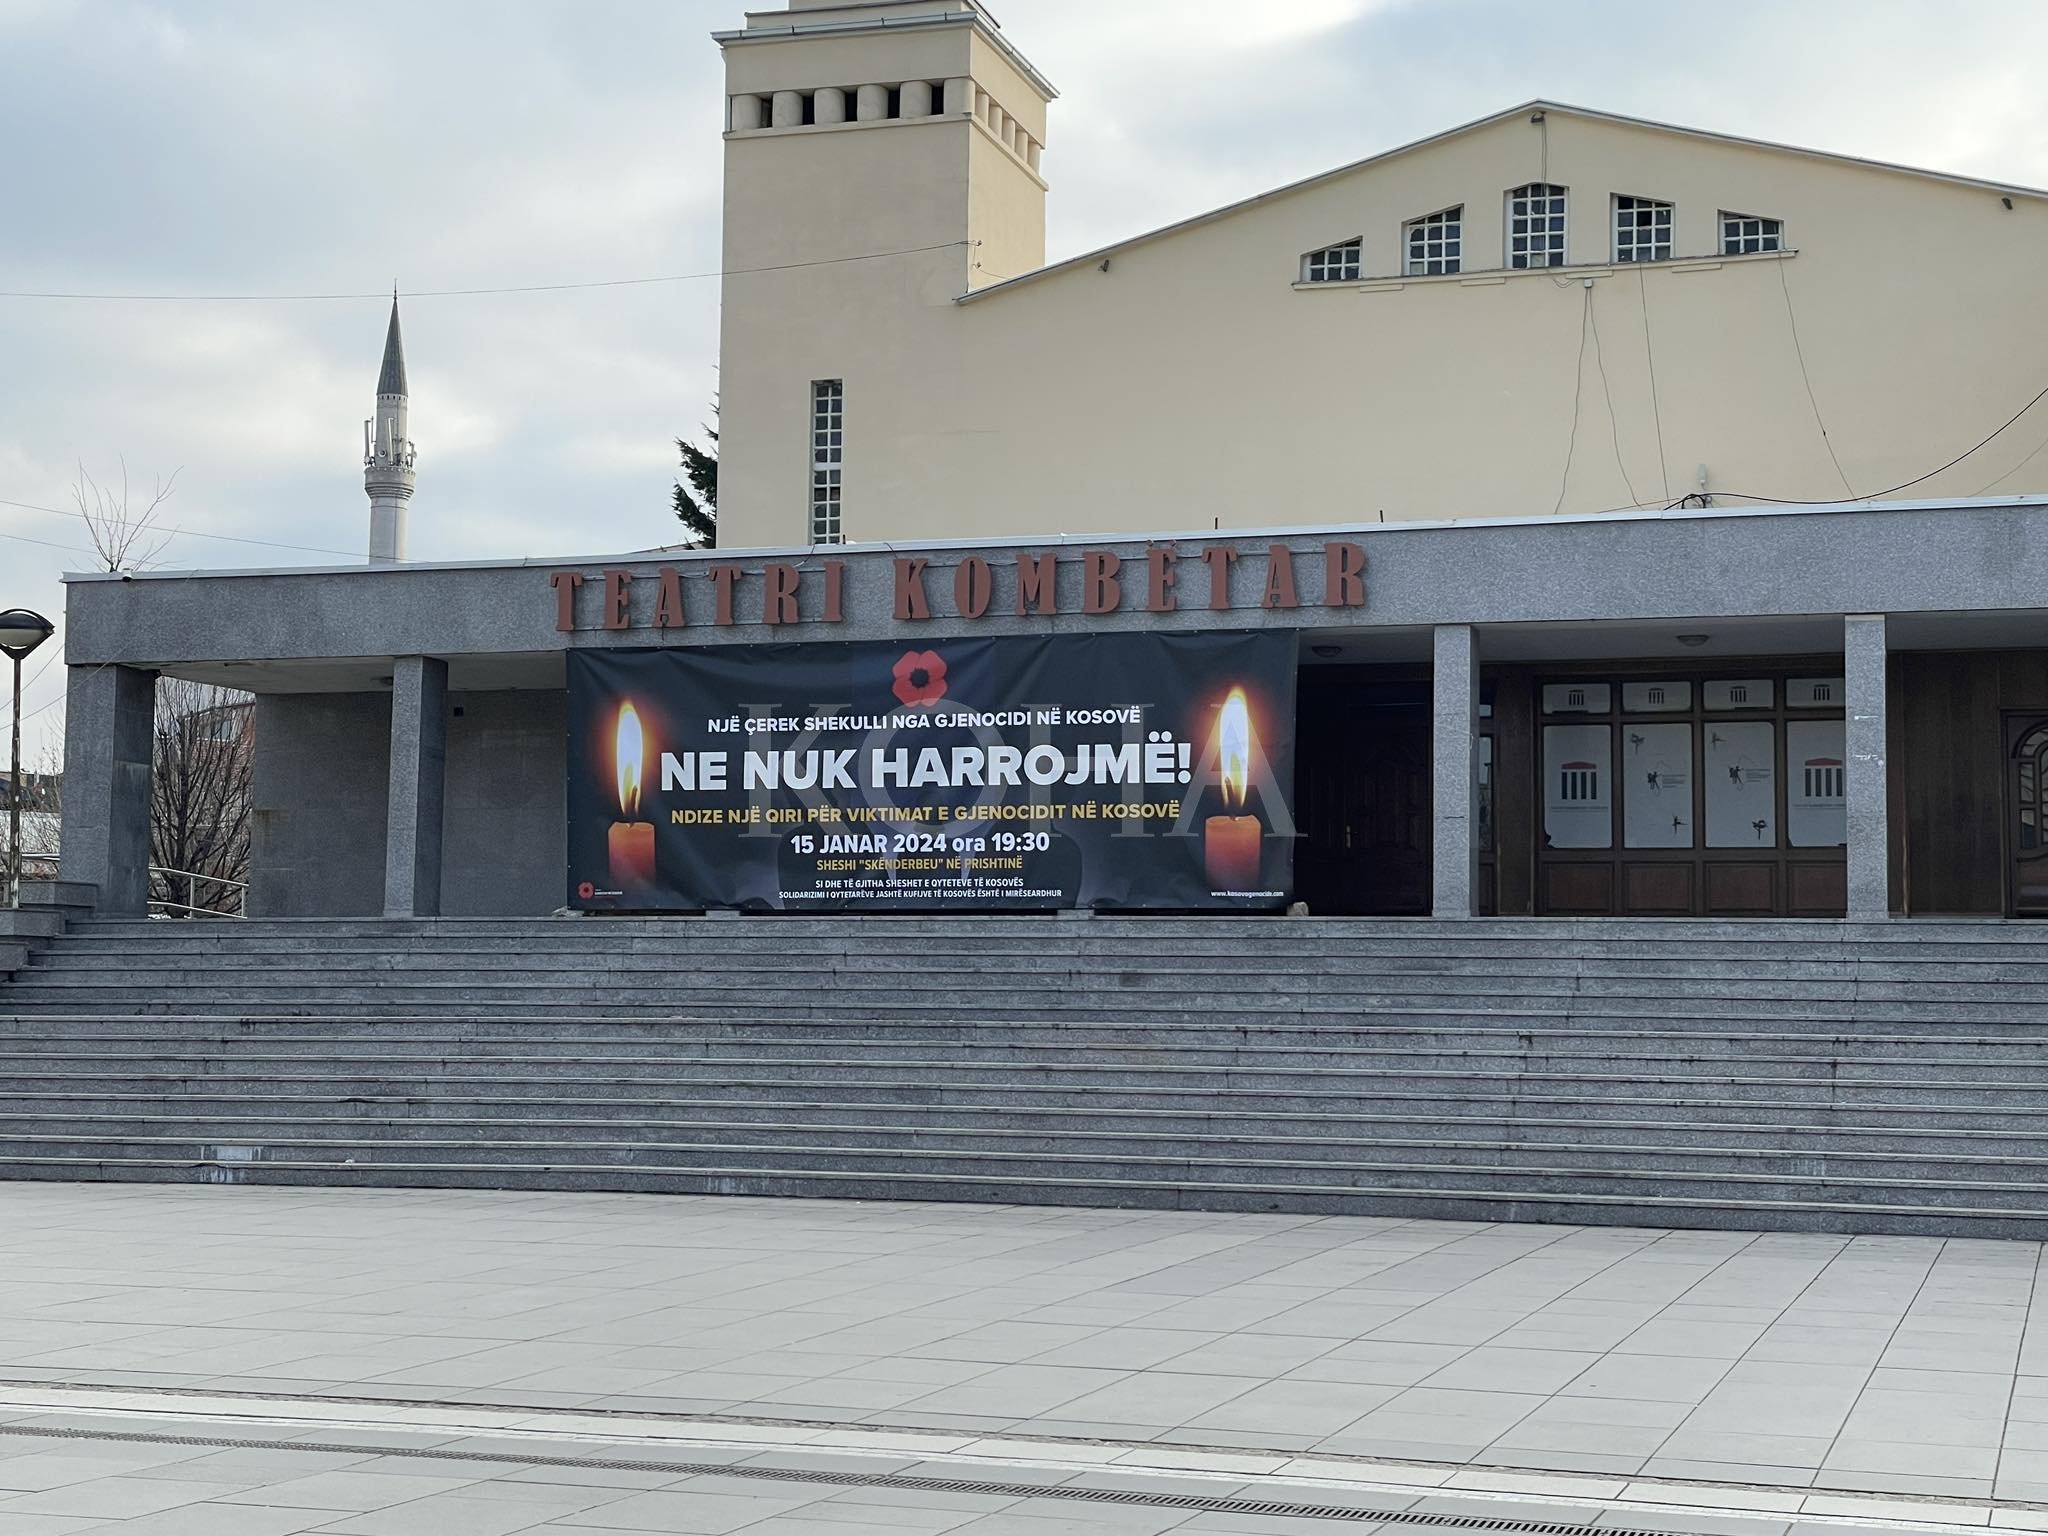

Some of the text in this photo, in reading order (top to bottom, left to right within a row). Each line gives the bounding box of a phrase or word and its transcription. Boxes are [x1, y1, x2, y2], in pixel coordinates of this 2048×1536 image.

[551, 539, 1367, 631] TEATRI KOMBËTAR
[707, 705, 1141, 736] NJË ÇEREK SHEKULLI NGA GJENOCIDI NË KOSOVË
[660, 731, 1192, 791] NE NUK HARROJMË!
[671, 800, 1180, 824] NDIZE NJË QIRI PËR VIKTIMAT E GJENOCIDIT NË KOSOVË
[790, 832, 1050, 854] 15 JANAR 2024 ora 19:30
[816, 855, 1023, 871] SHESHI "SKËNDERBEU" NË PRISHTINË
[778, 891, 825, 899] SOLIDARIZIMI
[830, 889, 874, 899] QYTETARËVE
[876, 888, 902, 898] JASHTË
[933, 888, 941, 898] TË
[943, 888, 976, 898] KOSOVËS
[977, 888, 1000, 897] ËSHTË
[1005, 888, 1062, 897] MIRËSEARDHUR
[815, 877, 1024, 889] SI DHE TË GJITHA SHESHET E QYTETEVE TË KOSOVËS
